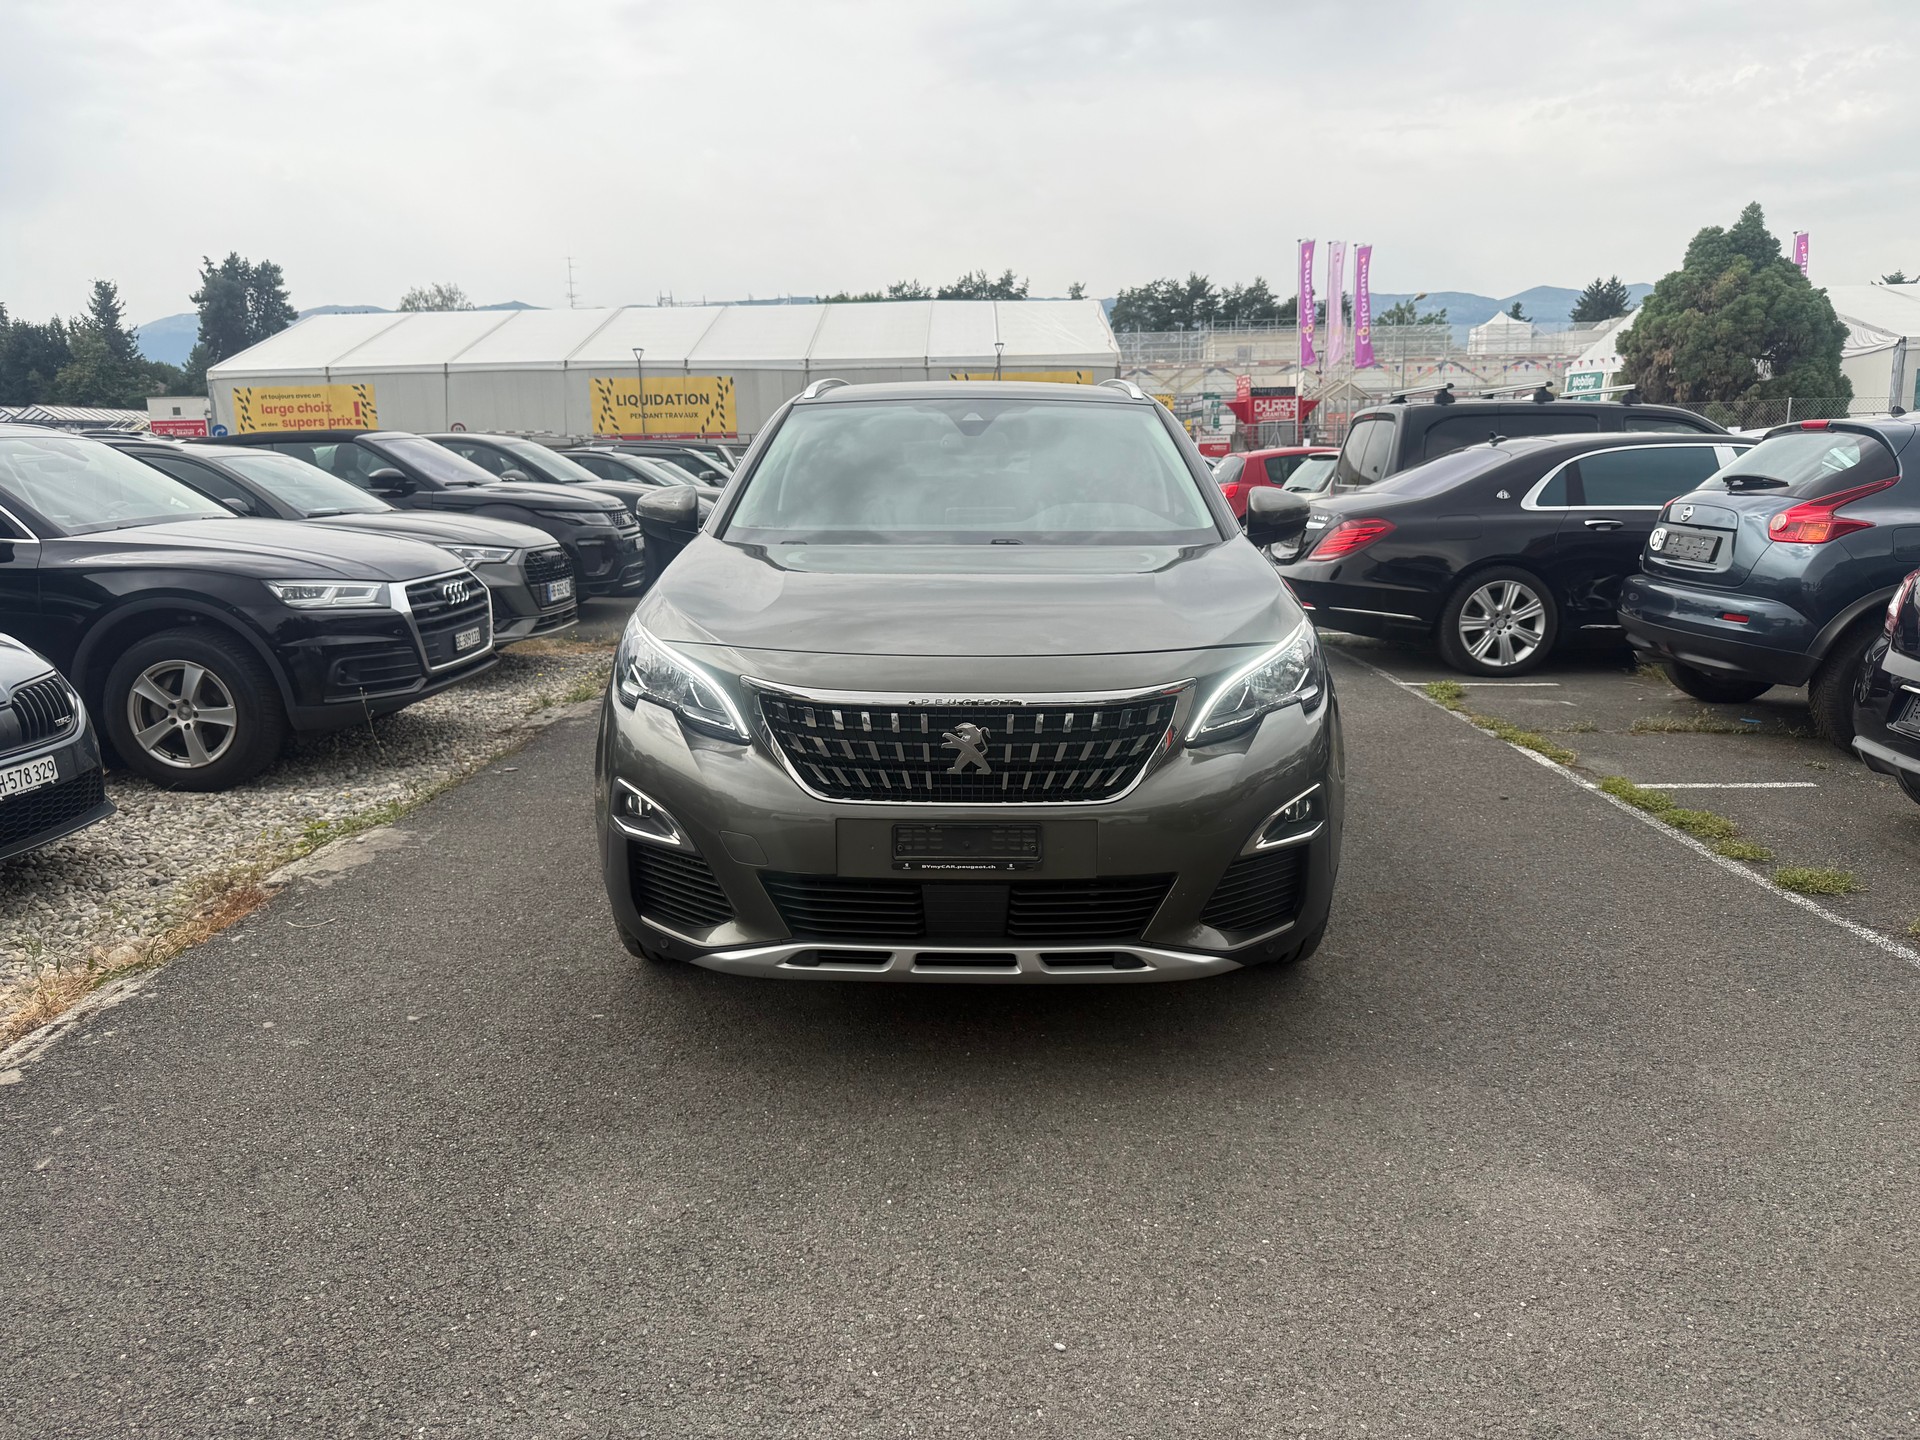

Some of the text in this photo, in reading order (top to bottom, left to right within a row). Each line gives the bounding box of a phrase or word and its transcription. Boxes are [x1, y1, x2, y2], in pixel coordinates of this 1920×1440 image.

[268, 393, 295, 401] toujours
[616, 393, 710, 407] LIQUIDATION
[261, 401, 333, 417] large choix
[630, 412, 663, 420] PENDANT
[282, 417, 325, 430] supers
[1652, 530, 1666, 547] CH
[33, 760, 55, 781] 329
